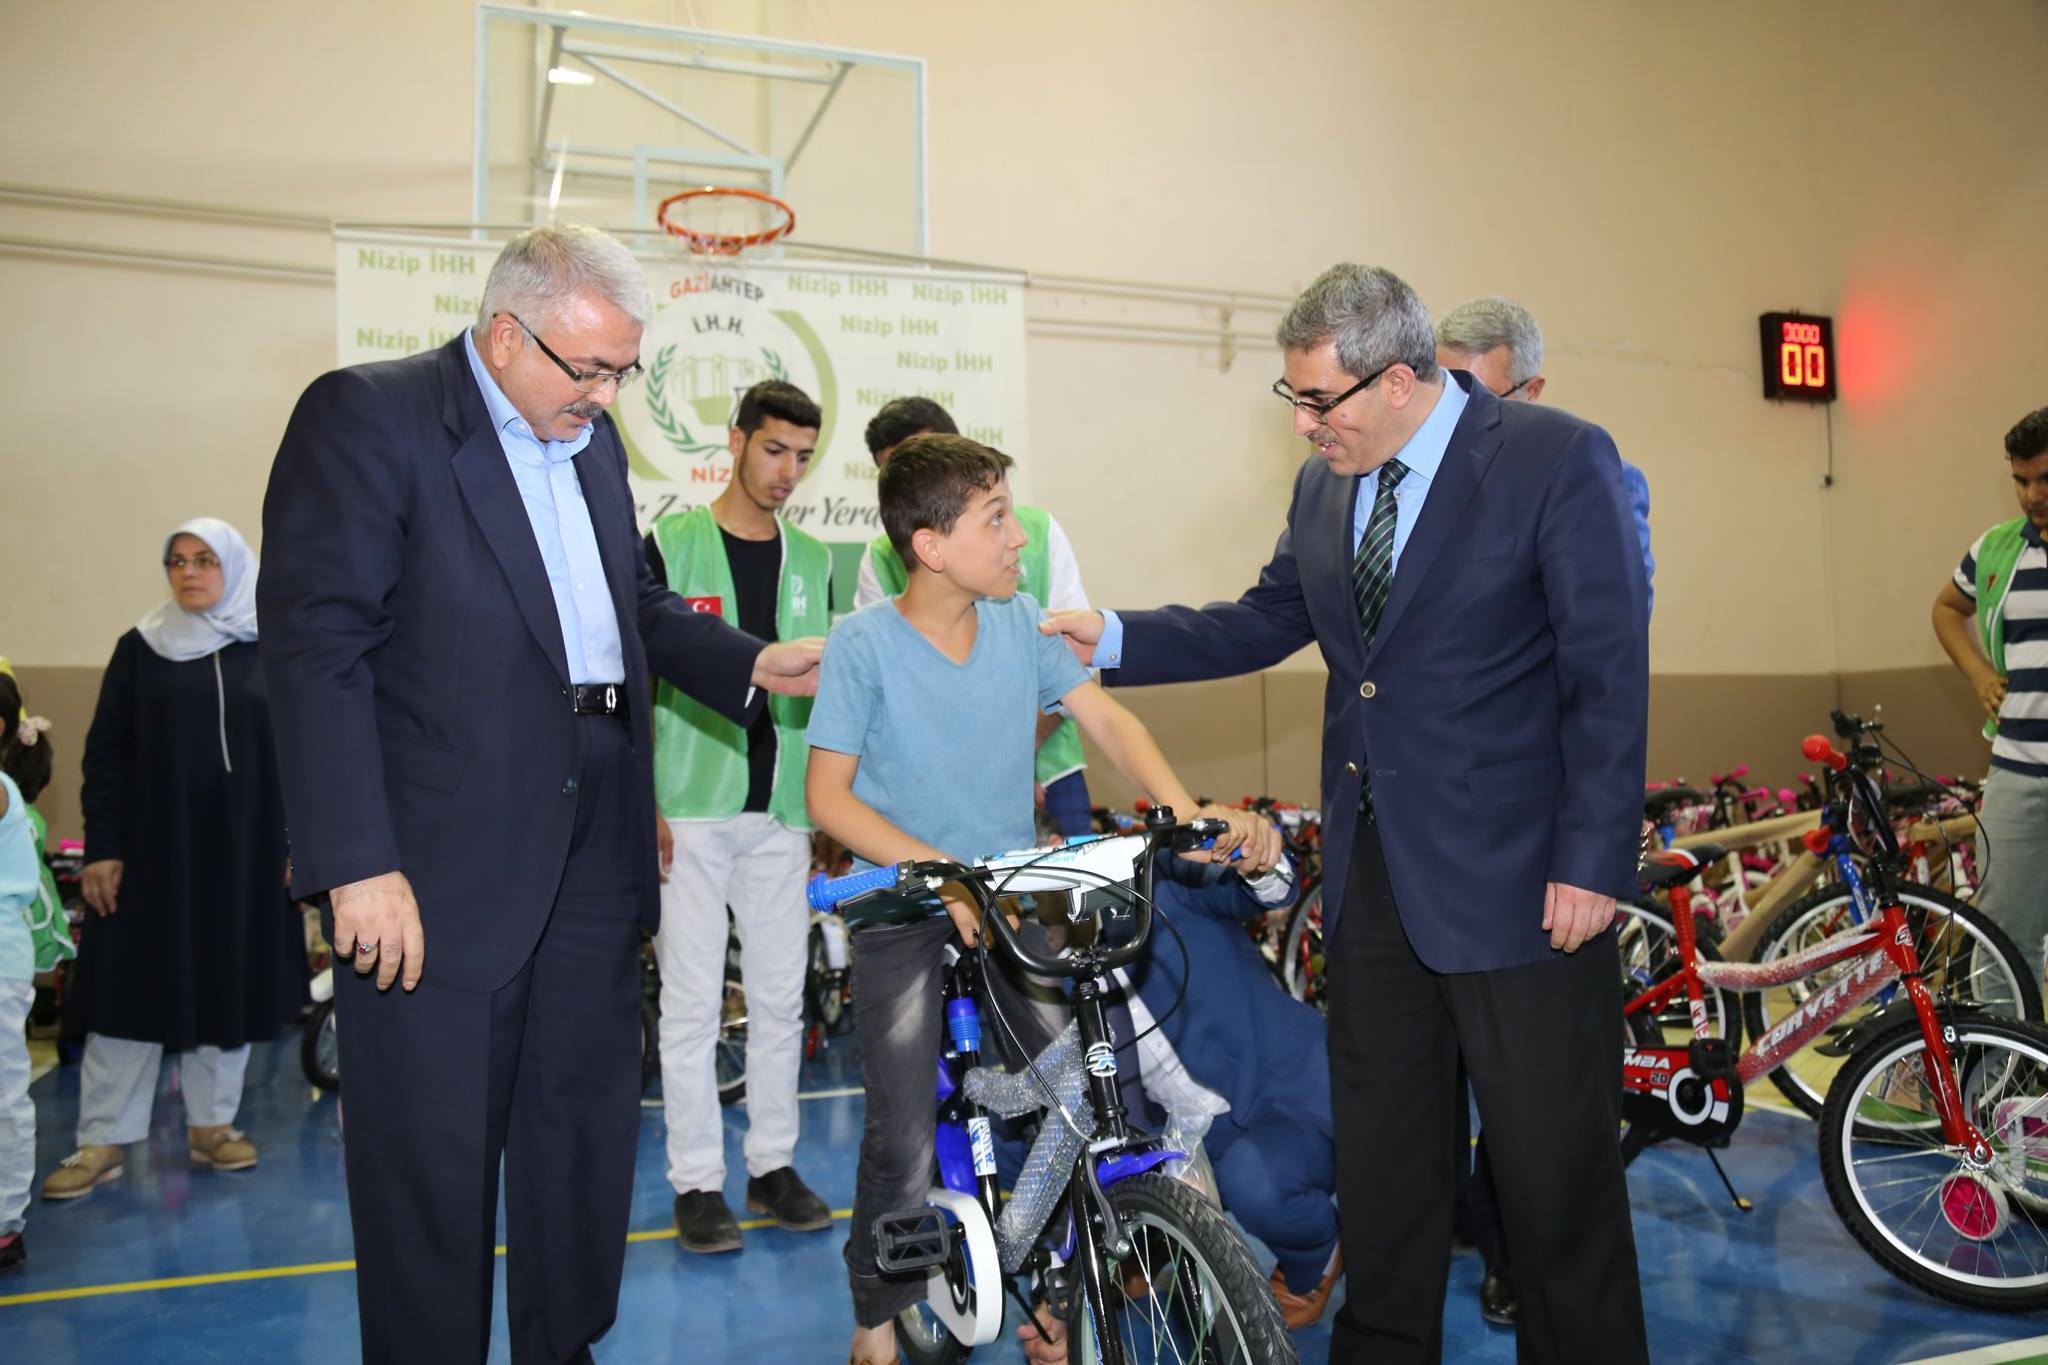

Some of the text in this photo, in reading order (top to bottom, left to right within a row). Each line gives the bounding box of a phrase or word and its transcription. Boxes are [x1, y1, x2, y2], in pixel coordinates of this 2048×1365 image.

[357, 248, 421, 275] Nizip
[787, 274, 841, 297] Nizip
[912, 282, 963, 305] Nizip
[433, 292, 480, 317] Nizi
[840, 315, 894, 338] Nizip
[356, 327, 420, 355] Nizip
[897, 350, 949, 374] Nizip
[1781, 342, 1825, 387] 00
[691, 463, 732, 482] NİZ
[843, 461, 879, 481] Niz
[1623, 1052, 1671, 1070] MBA
